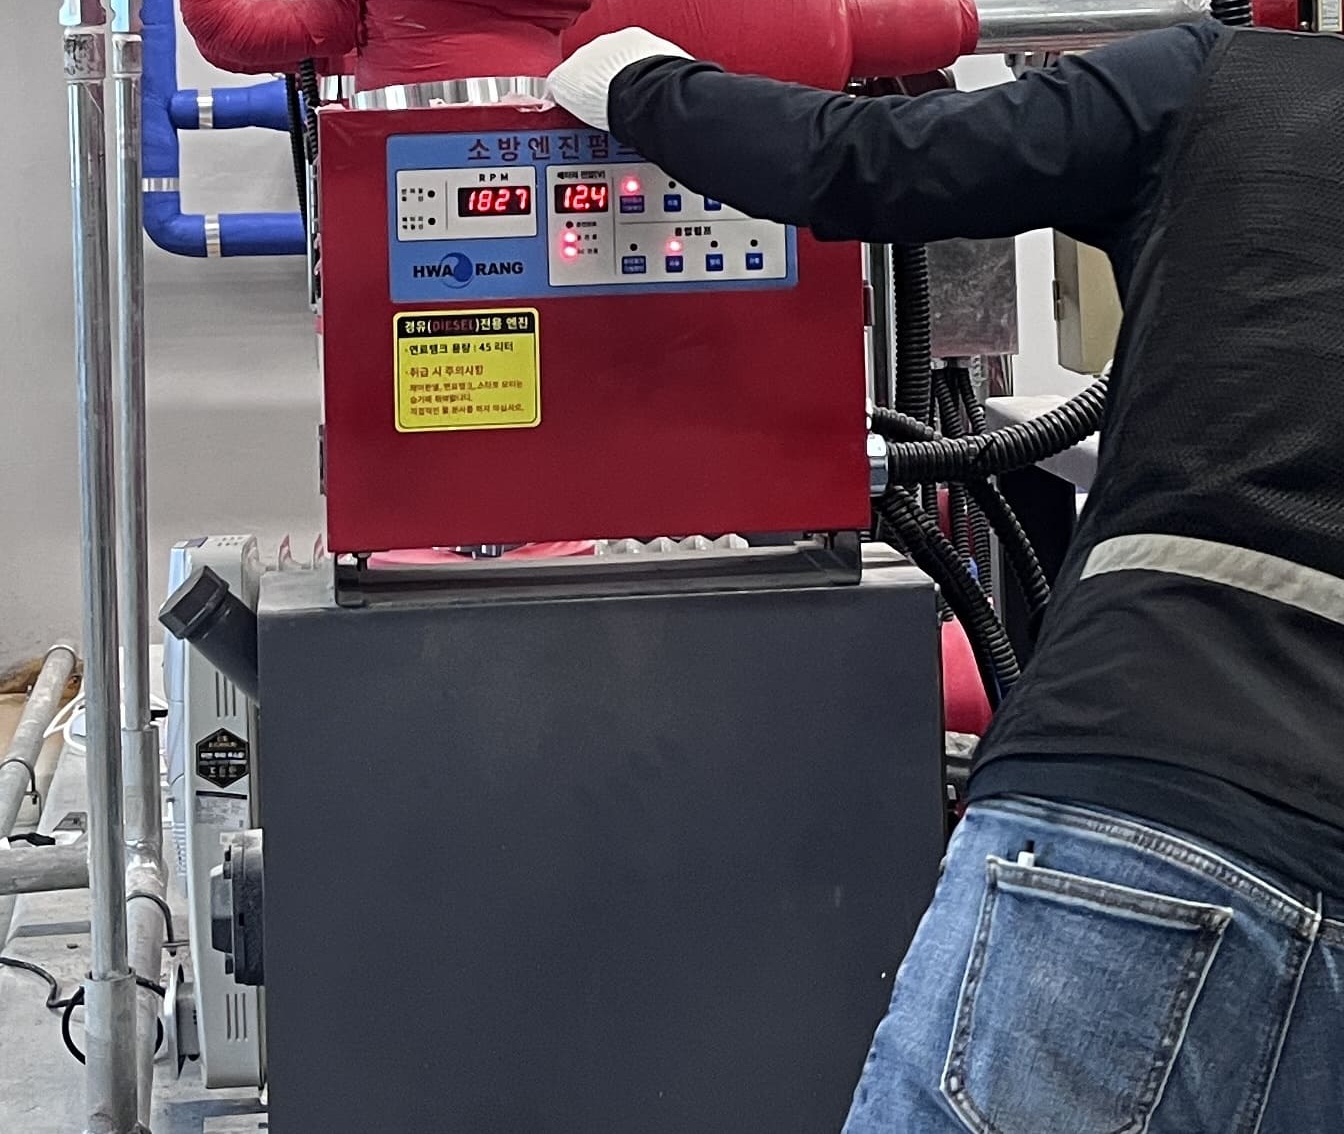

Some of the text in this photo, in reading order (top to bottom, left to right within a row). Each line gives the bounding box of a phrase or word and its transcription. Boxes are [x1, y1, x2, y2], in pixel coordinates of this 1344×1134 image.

[468, 188, 528, 212] 1827
[563, 184, 607, 210] 12.4
[505, 315, 529, 331] 엔진
[478, 342, 492, 352] 45
[494, 341, 514, 352] 리터
[432, 366, 442, 377] 시
